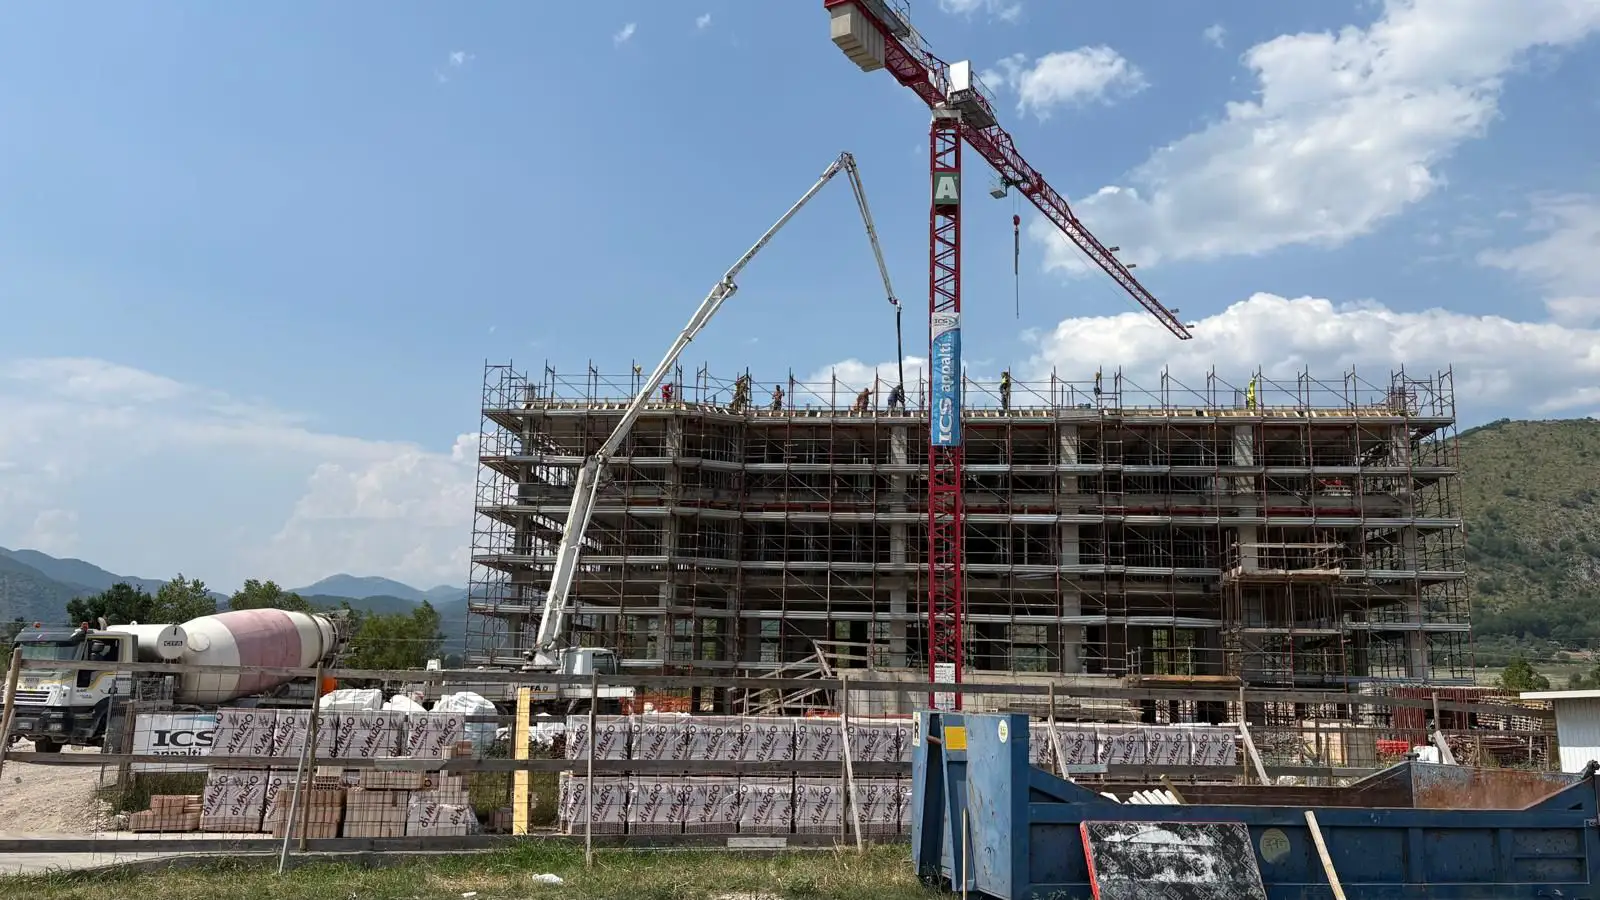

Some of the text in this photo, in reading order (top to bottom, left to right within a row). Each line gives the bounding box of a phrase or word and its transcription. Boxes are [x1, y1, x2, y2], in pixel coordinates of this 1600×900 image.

[935, 176, 958, 199] A
[938, 343, 954, 393] appalti
[939, 398, 953, 443] ICS
[153, 730, 214, 746] ICS
